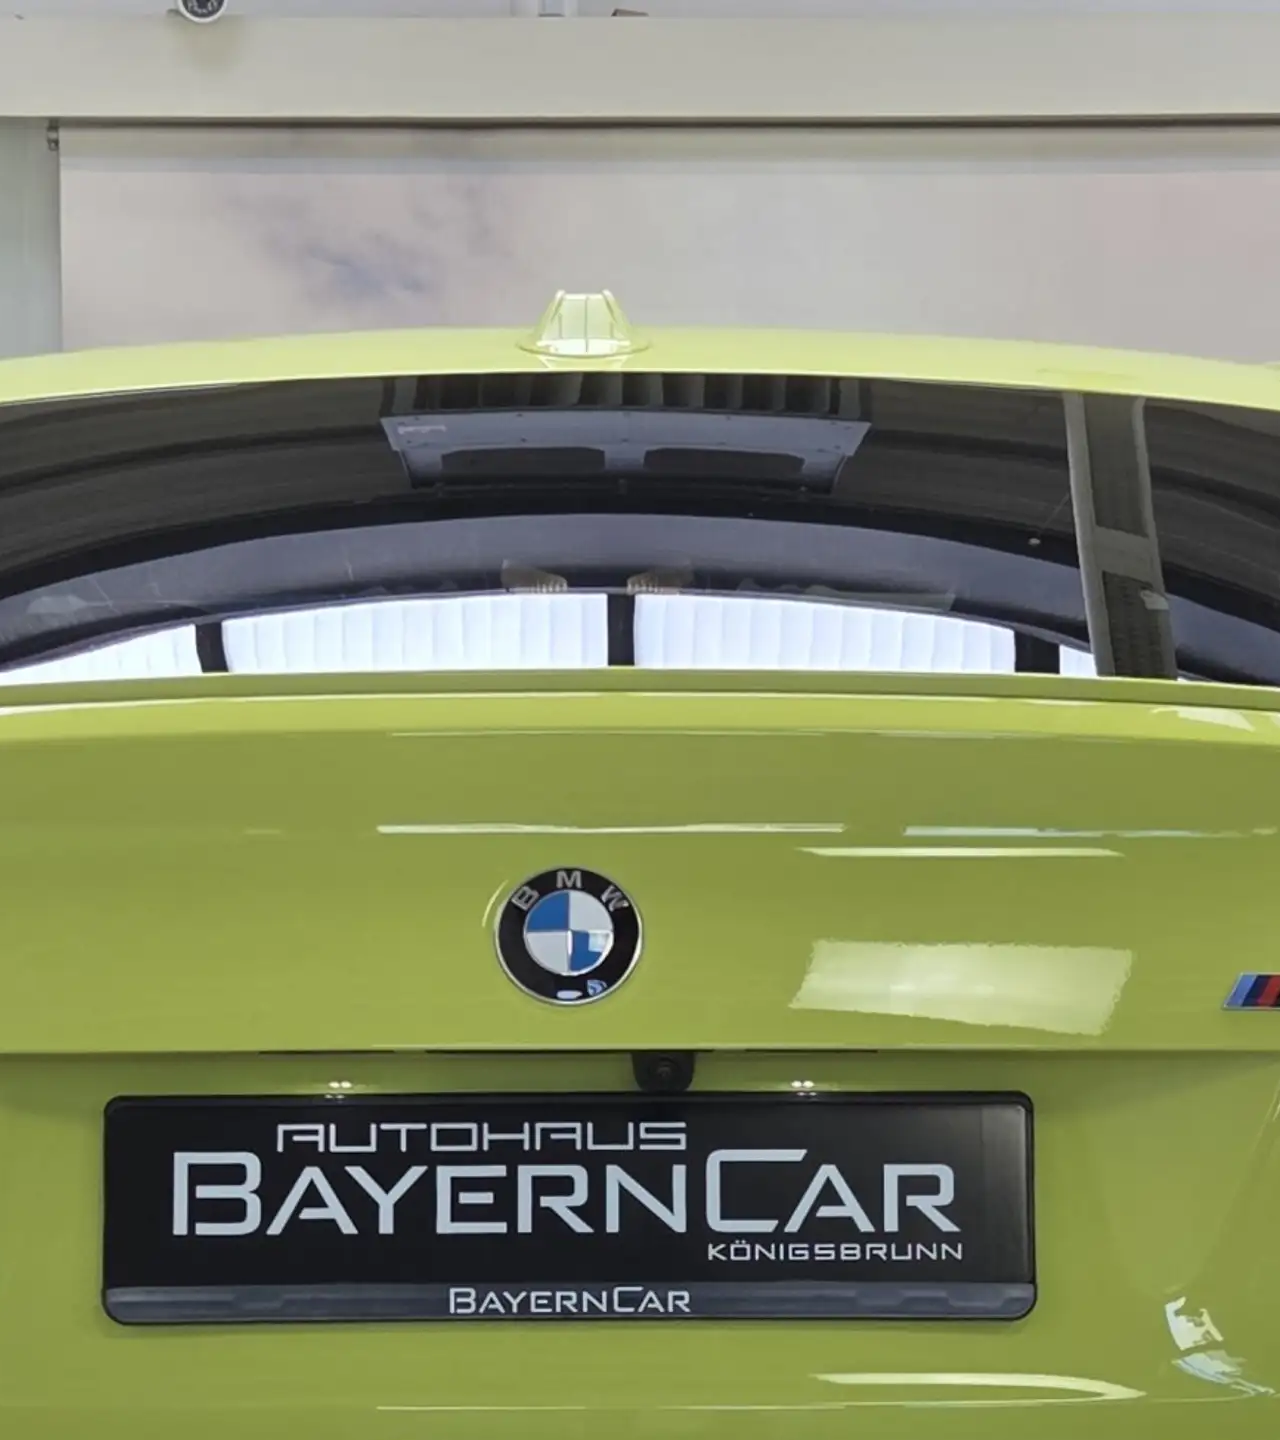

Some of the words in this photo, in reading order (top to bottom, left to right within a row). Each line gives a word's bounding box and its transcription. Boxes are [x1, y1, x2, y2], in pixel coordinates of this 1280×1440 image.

[511, 870, 629, 912] BMW
[276, 1121, 687, 1153] AUTOHAUS
[707, 1239, 962, 1261] KÖNIGSBRUNN
